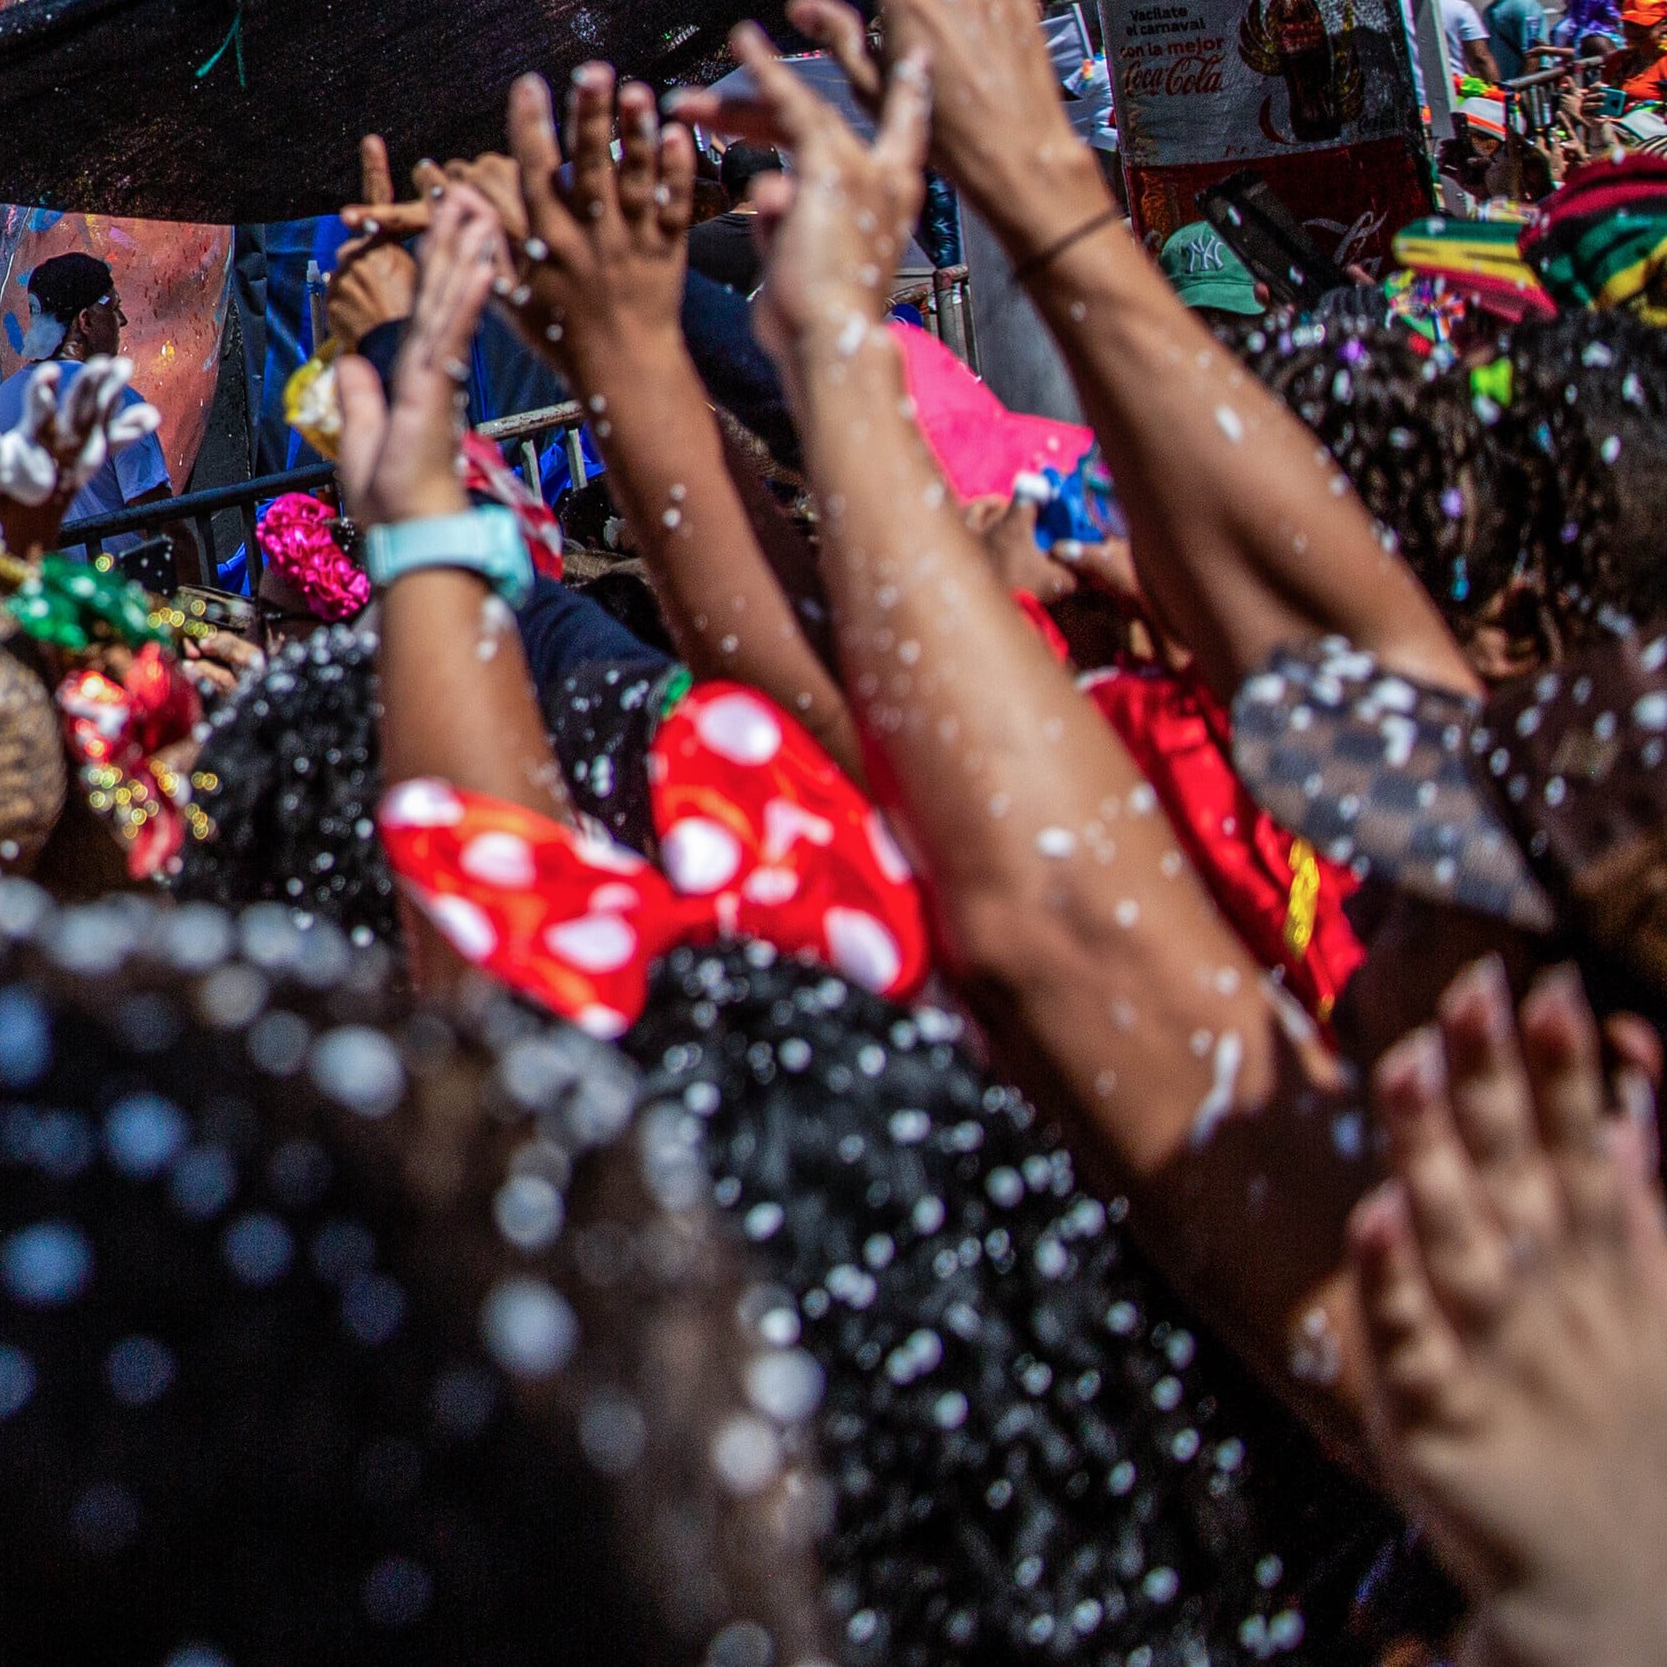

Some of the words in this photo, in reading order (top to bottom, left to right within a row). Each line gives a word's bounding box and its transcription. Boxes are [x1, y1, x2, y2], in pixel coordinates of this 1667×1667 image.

[1140, 17, 1207, 35] carnaval
[1148, 41, 1163, 56] la
[1168, 36, 1224, 55] mejor
[1186, 233, 1225, 273] NY
